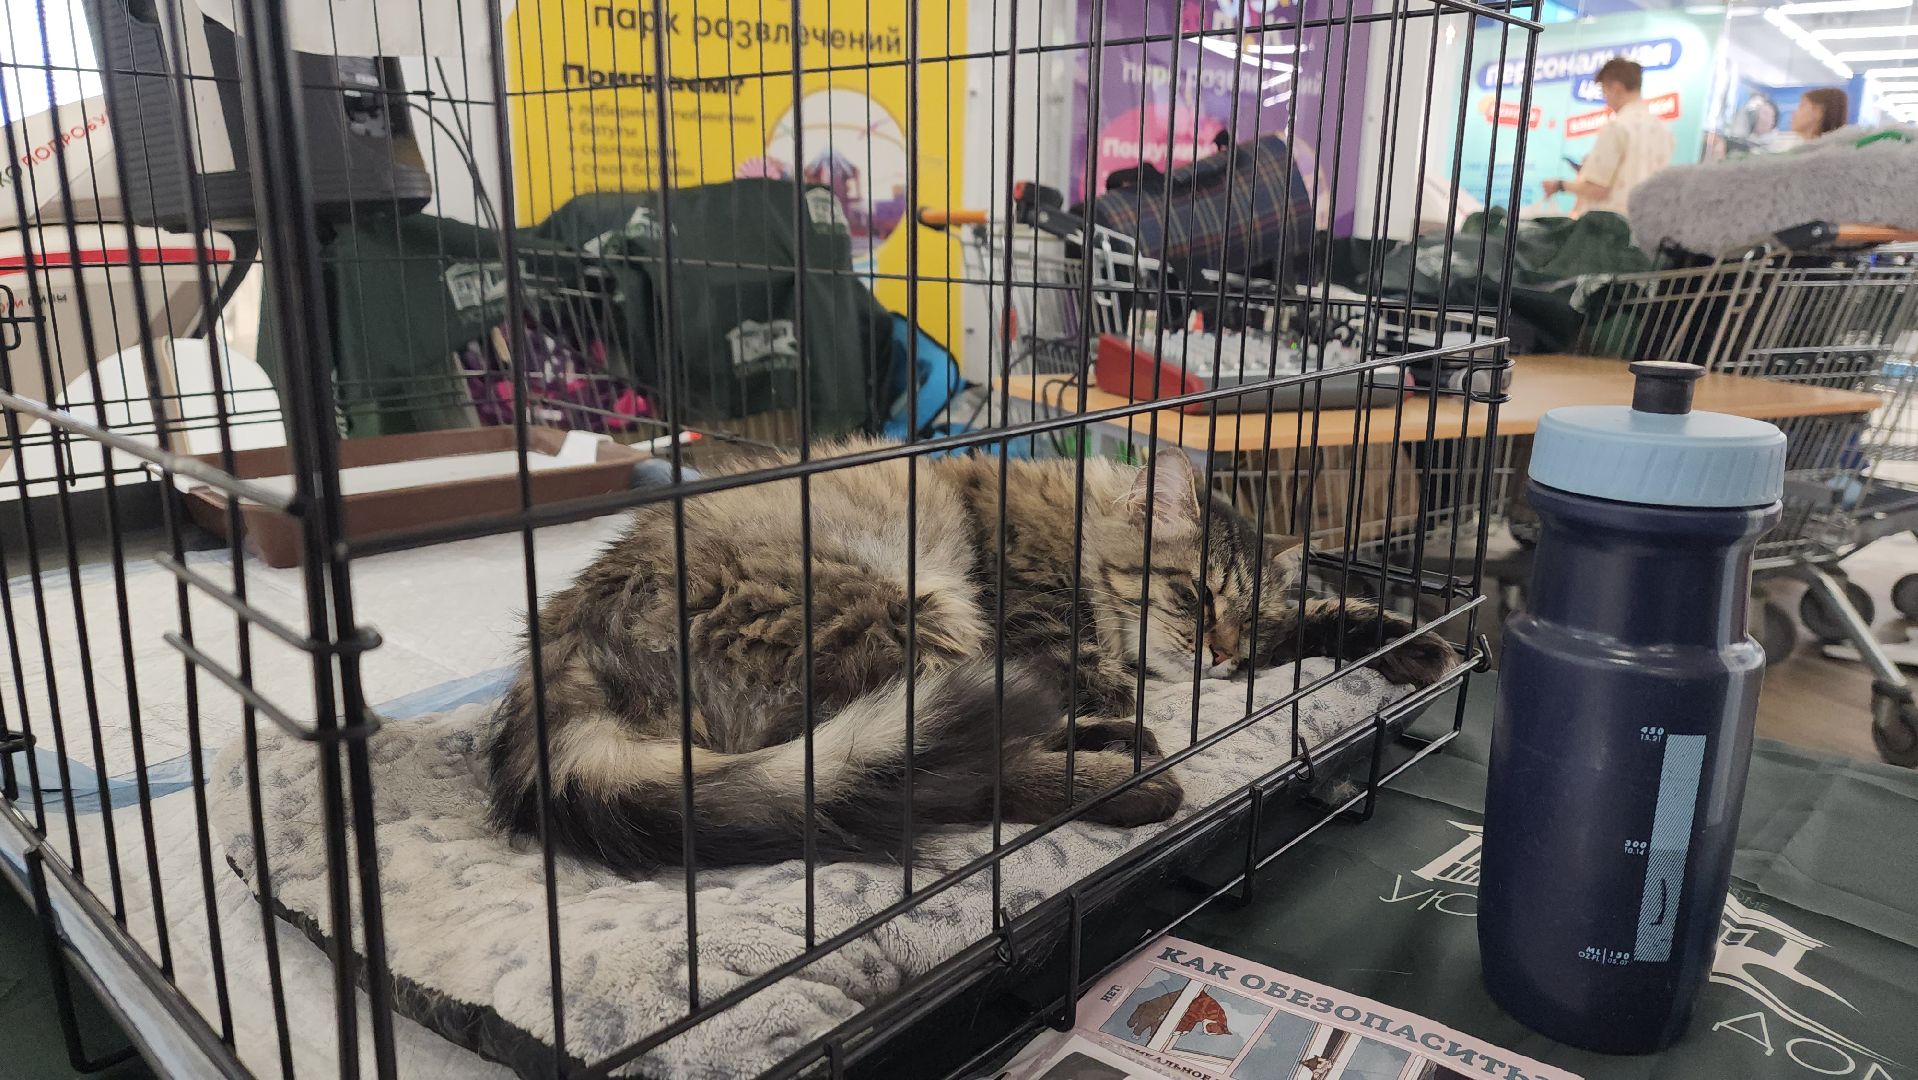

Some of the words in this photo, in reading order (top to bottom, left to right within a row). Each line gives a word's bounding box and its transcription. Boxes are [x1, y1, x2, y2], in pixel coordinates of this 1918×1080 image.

[594, 6, 680, 40] парк
[693, 14, 901, 55] развлечений
[563, 63, 744, 95] Поиграем?
[1640, 726, 1665, 735] 450
[1625, 840, 1647, 849] 300
[1625, 847, 1645, 855] 10.14
[1609, 950, 1630, 960] 150
[1157, 946, 1236, 980] КАК
[1240, 974, 1533, 1080] ОБЕЗОПАСИТЬ
